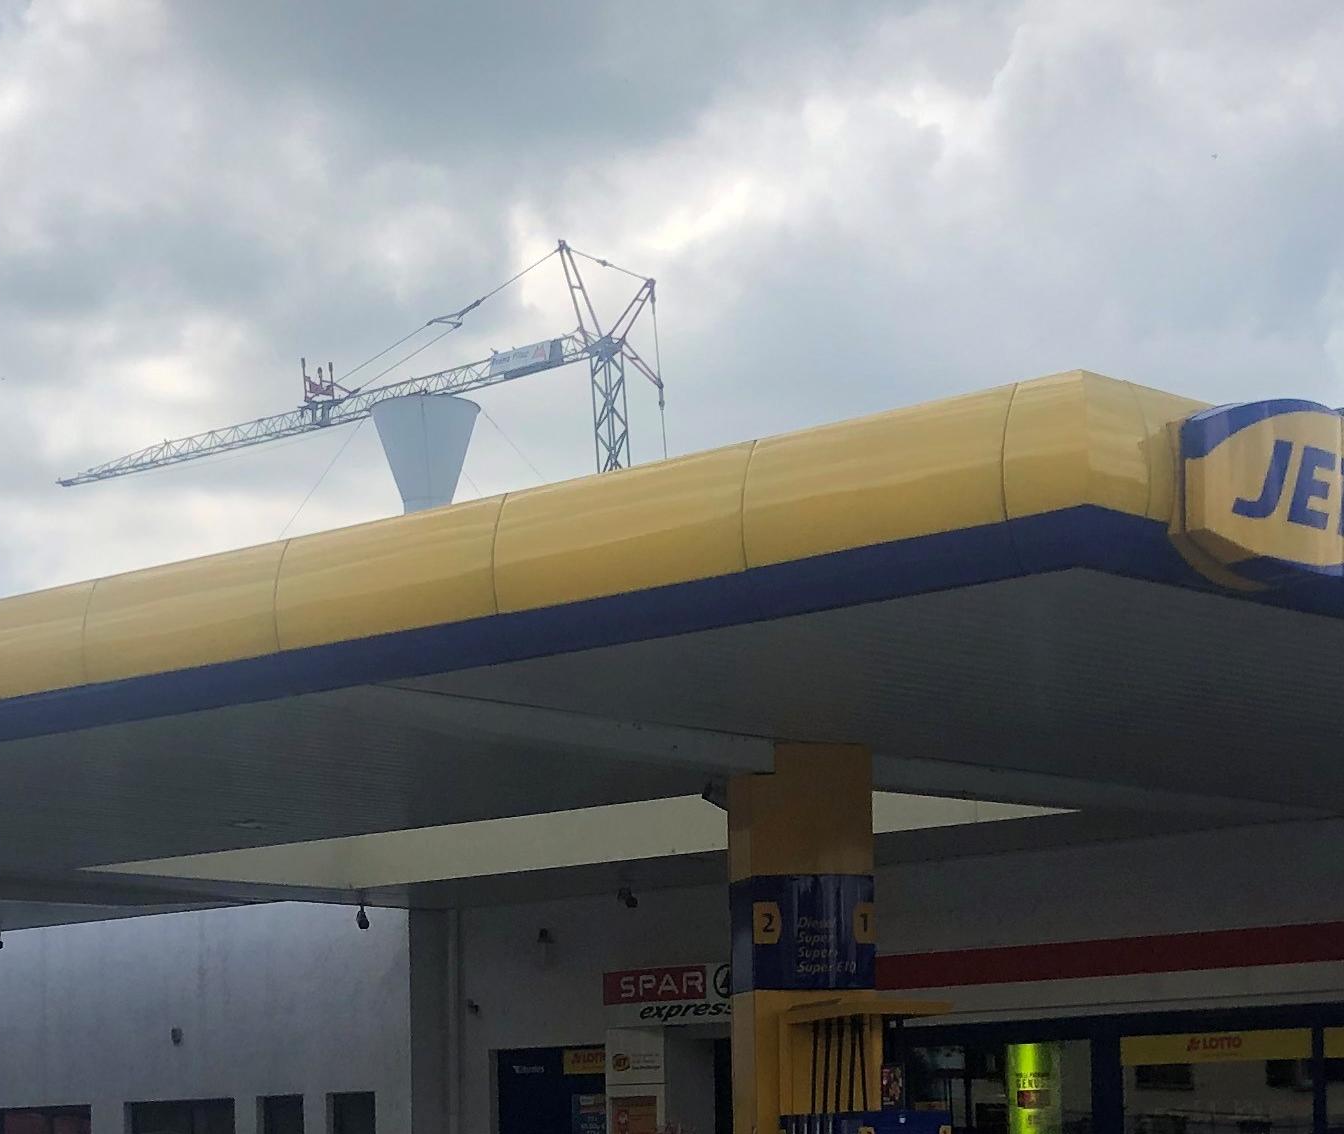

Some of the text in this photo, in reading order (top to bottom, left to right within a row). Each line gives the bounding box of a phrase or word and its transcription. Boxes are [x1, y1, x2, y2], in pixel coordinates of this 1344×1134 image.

[761, 912, 775, 933] 2
[859, 912, 868, 933] 1
[797, 931, 834, 945] Super
[796, 960, 834, 975] Super
[620, 971, 704, 998] SPAR
[1202, 1036, 1243, 1050] LOTTO
